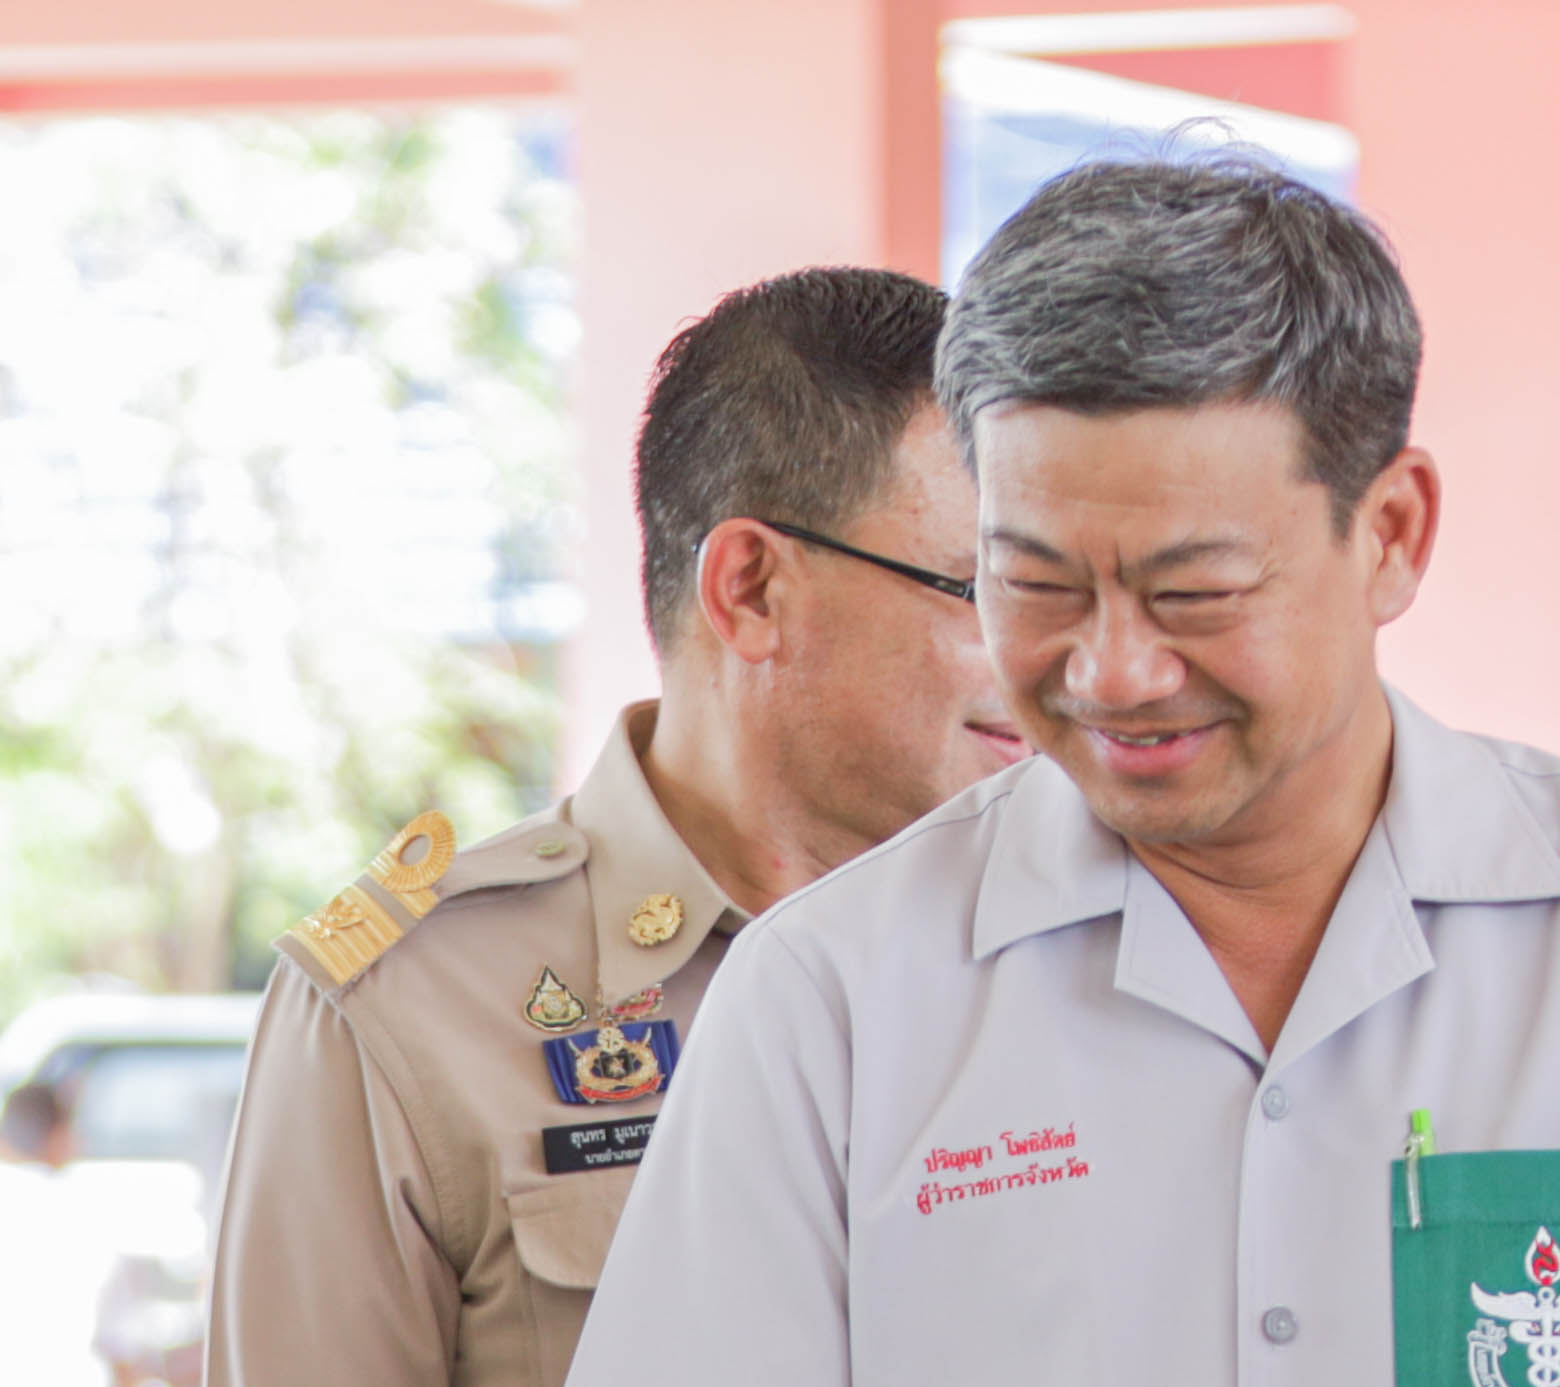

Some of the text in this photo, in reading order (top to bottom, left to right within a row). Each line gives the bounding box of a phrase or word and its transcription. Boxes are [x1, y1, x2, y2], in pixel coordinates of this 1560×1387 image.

[923, 1145, 993, 1174] ปริญญา
[916, 1157, 1091, 1215] ผู้ว่าราชการจังหวัด
